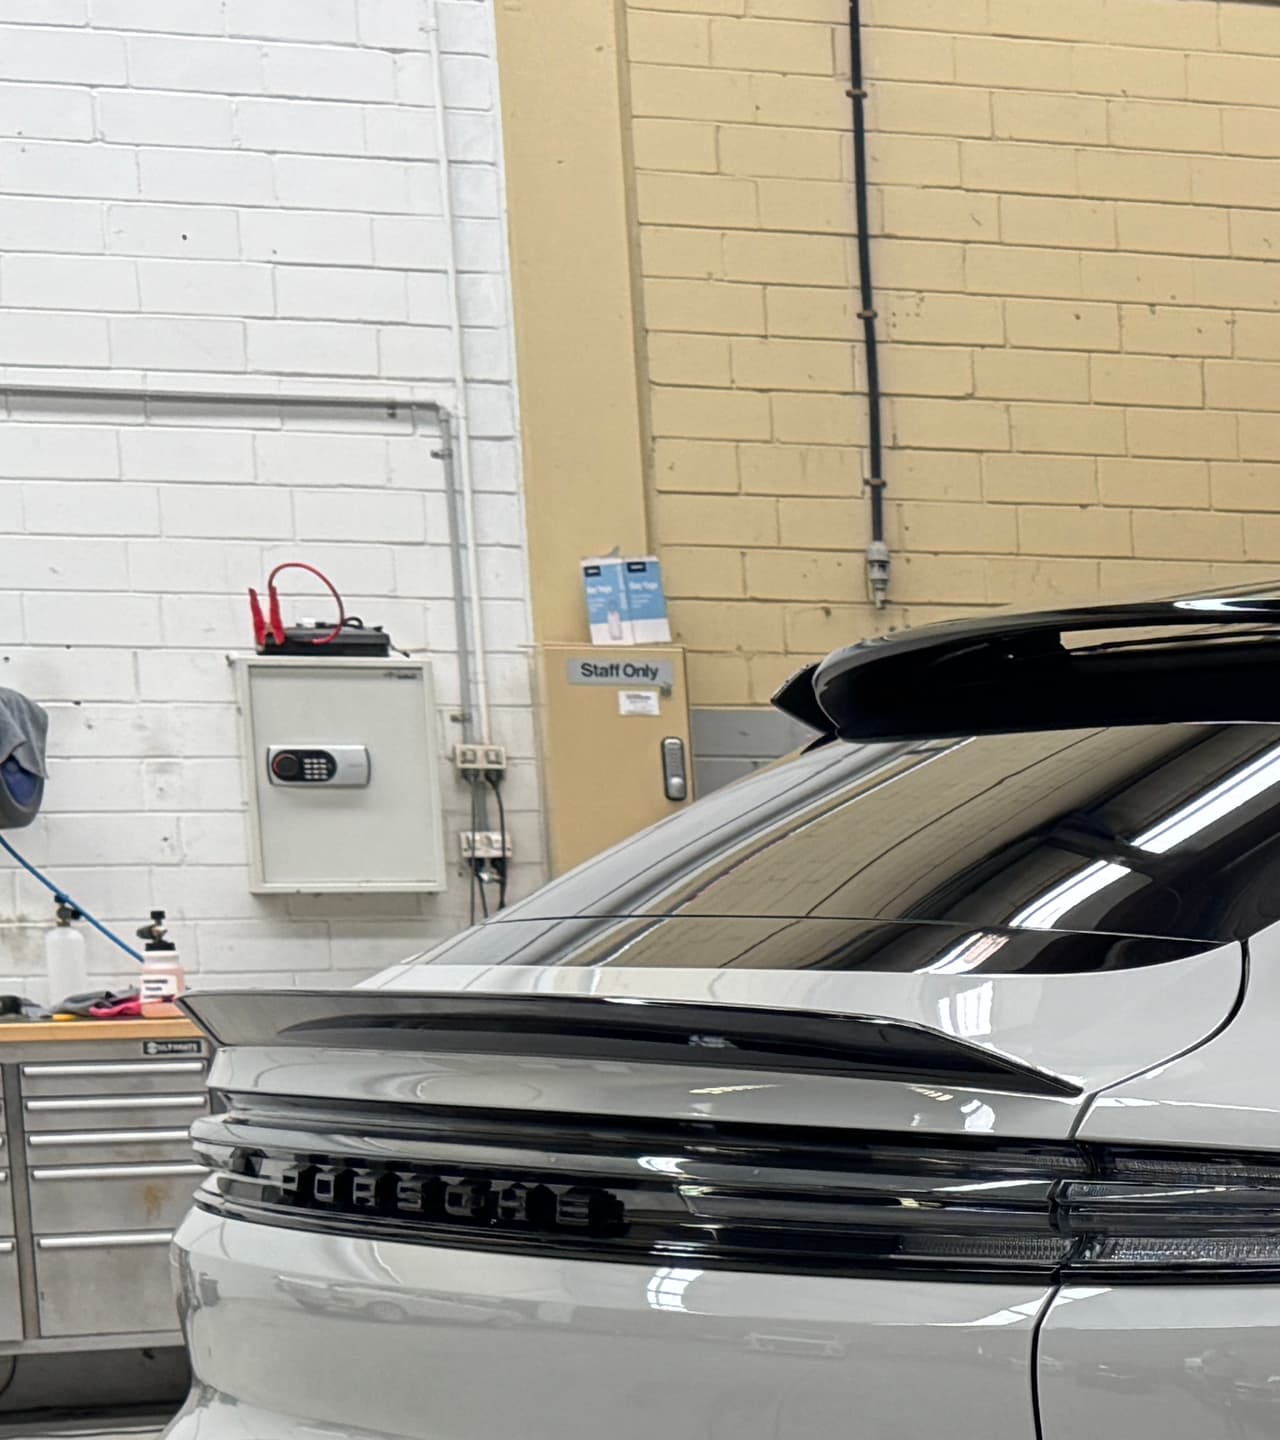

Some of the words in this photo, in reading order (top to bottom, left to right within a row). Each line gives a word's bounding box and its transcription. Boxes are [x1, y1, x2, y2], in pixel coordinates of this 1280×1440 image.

[580, 662, 620, 678] Staff
[623, 662, 659, 680] Only
[281, 1163, 594, 1229] PORSCHE
